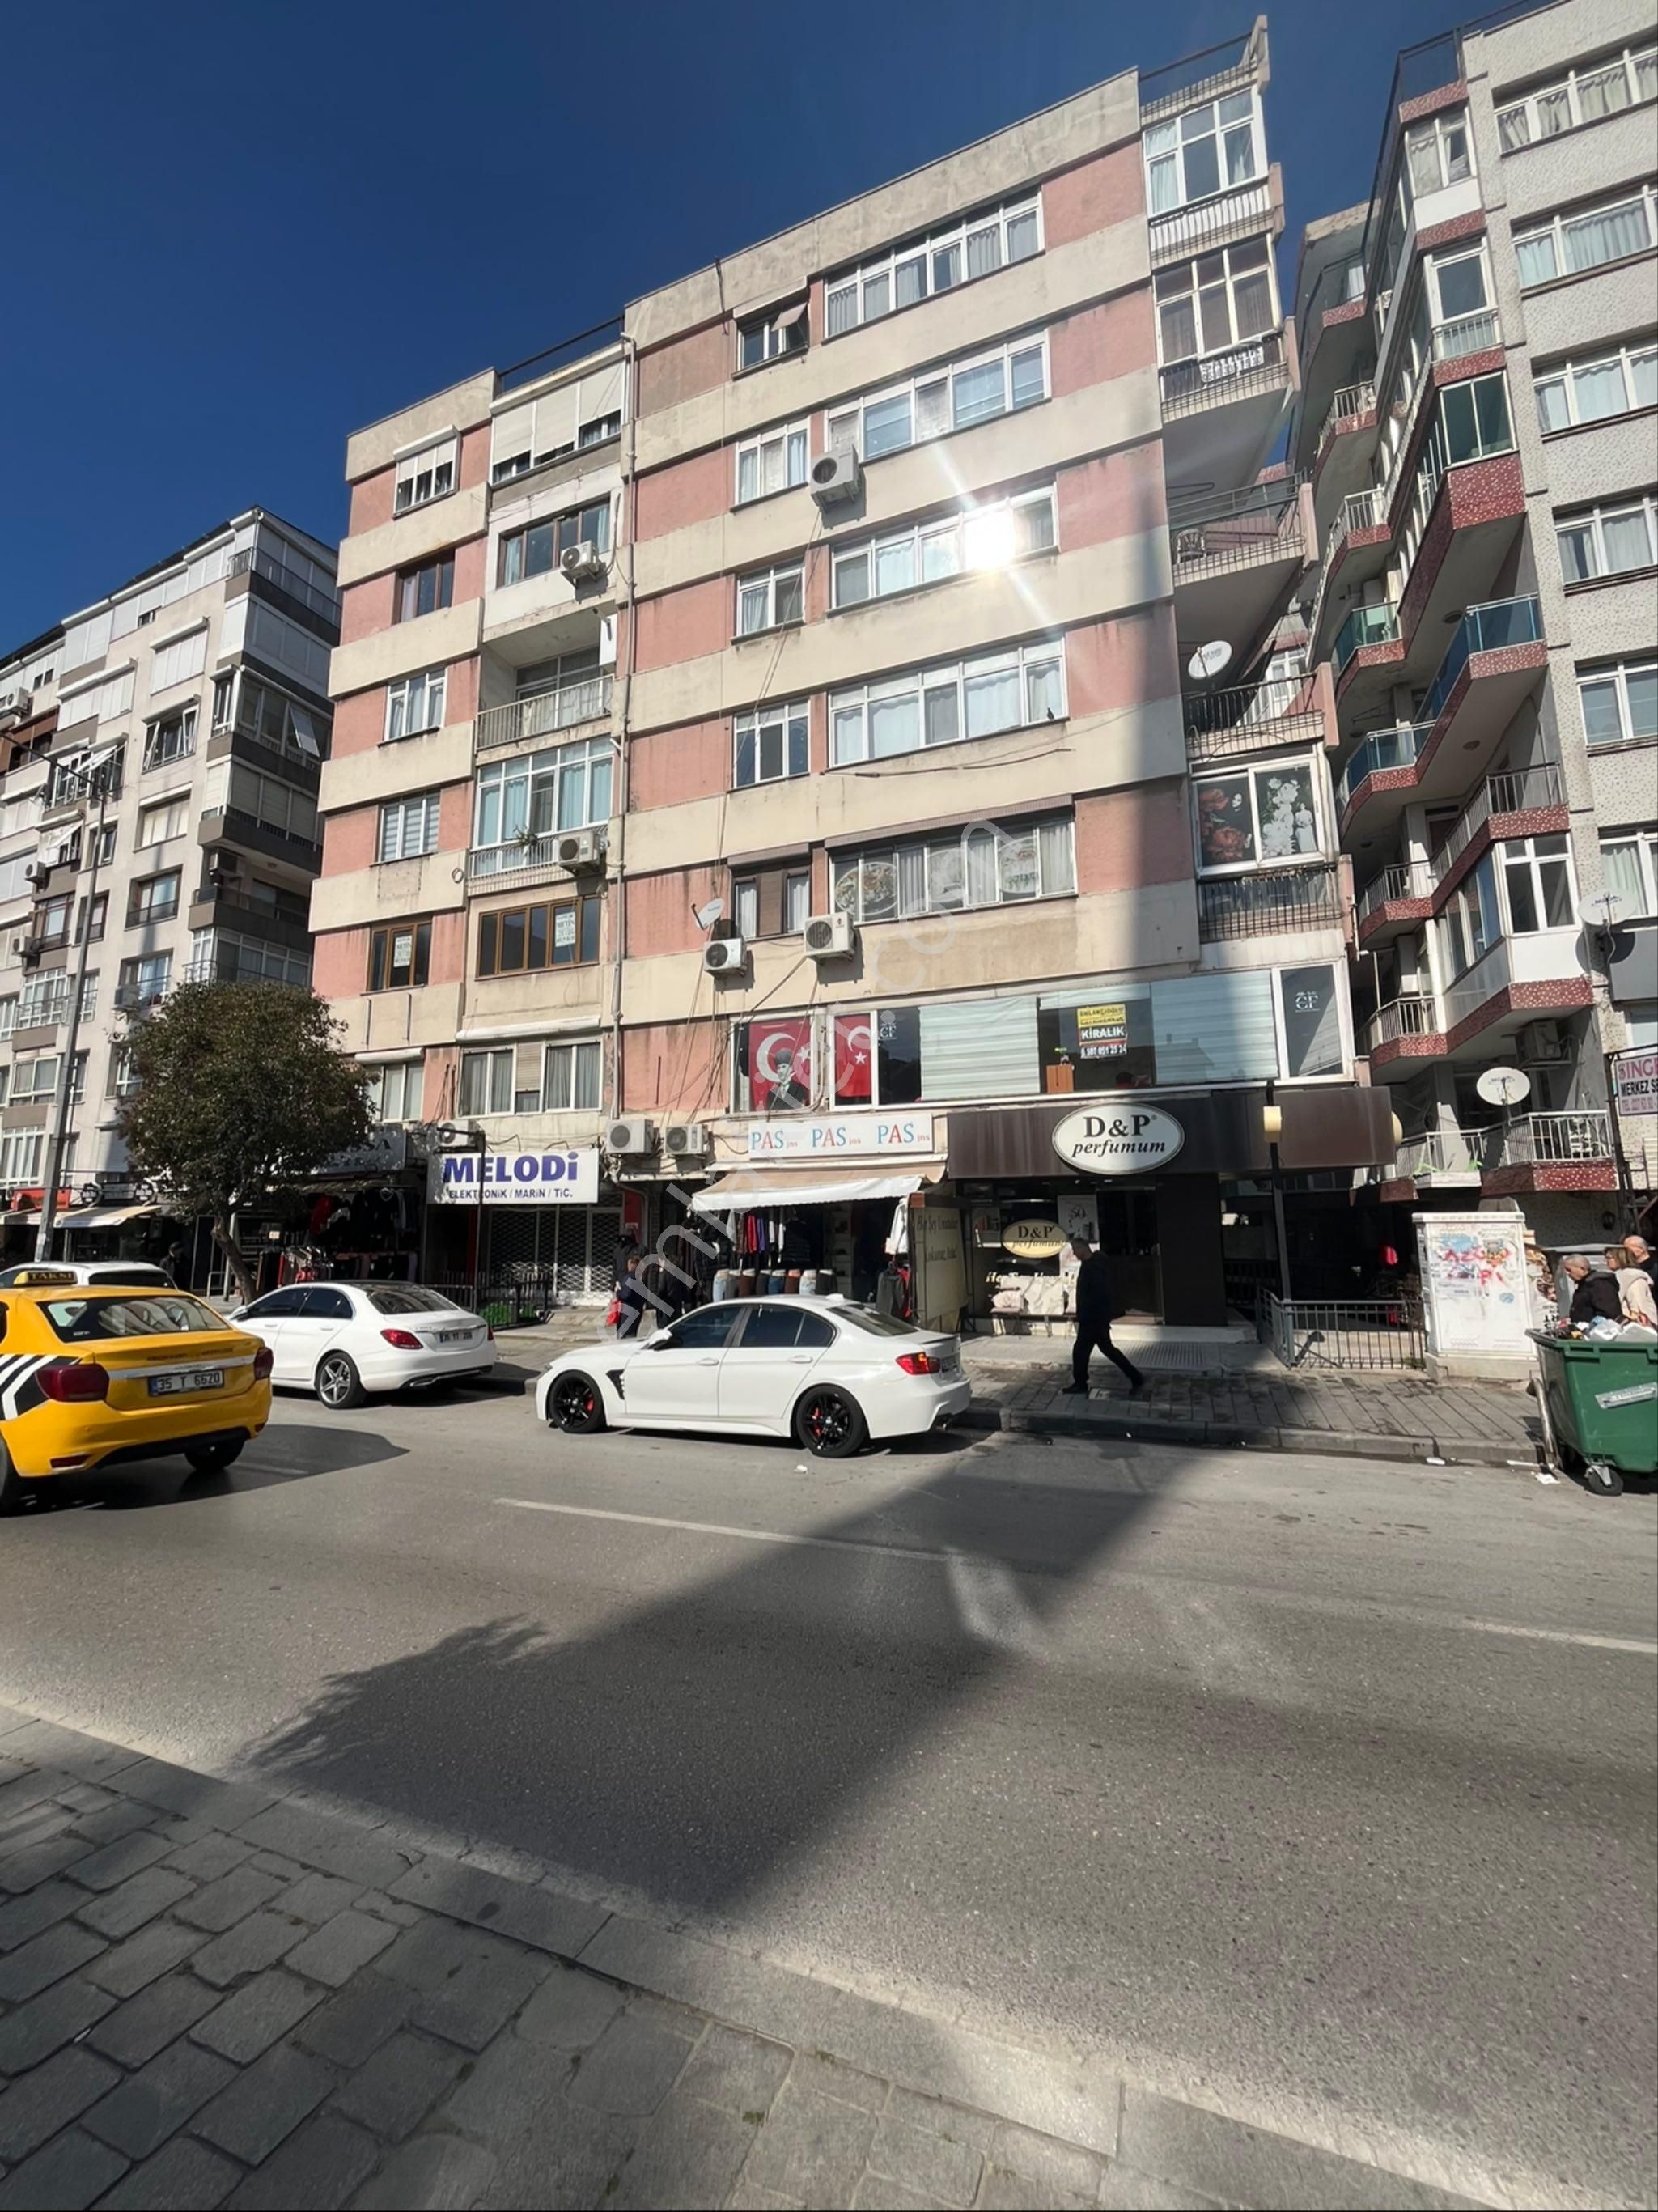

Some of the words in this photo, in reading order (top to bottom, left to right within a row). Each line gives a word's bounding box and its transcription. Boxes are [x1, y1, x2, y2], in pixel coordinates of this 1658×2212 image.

[1081, 1026, 1125, 1041] KİRALIK
[1621, 1080, 1649, 1097] MERKEZ
[1083, 1114, 1151, 1138] D&P
[751, 1130, 784, 1151] PAS
[812, 1127, 846, 1148] PAS
[877, 1122, 914, 1144] PAS
[1071, 1139, 1166, 1157] perfumum
[1018, 1225, 1053, 1238] D&P
[158, 1378, 172, 1390] 35
[180, 1377, 186, 1388] T
